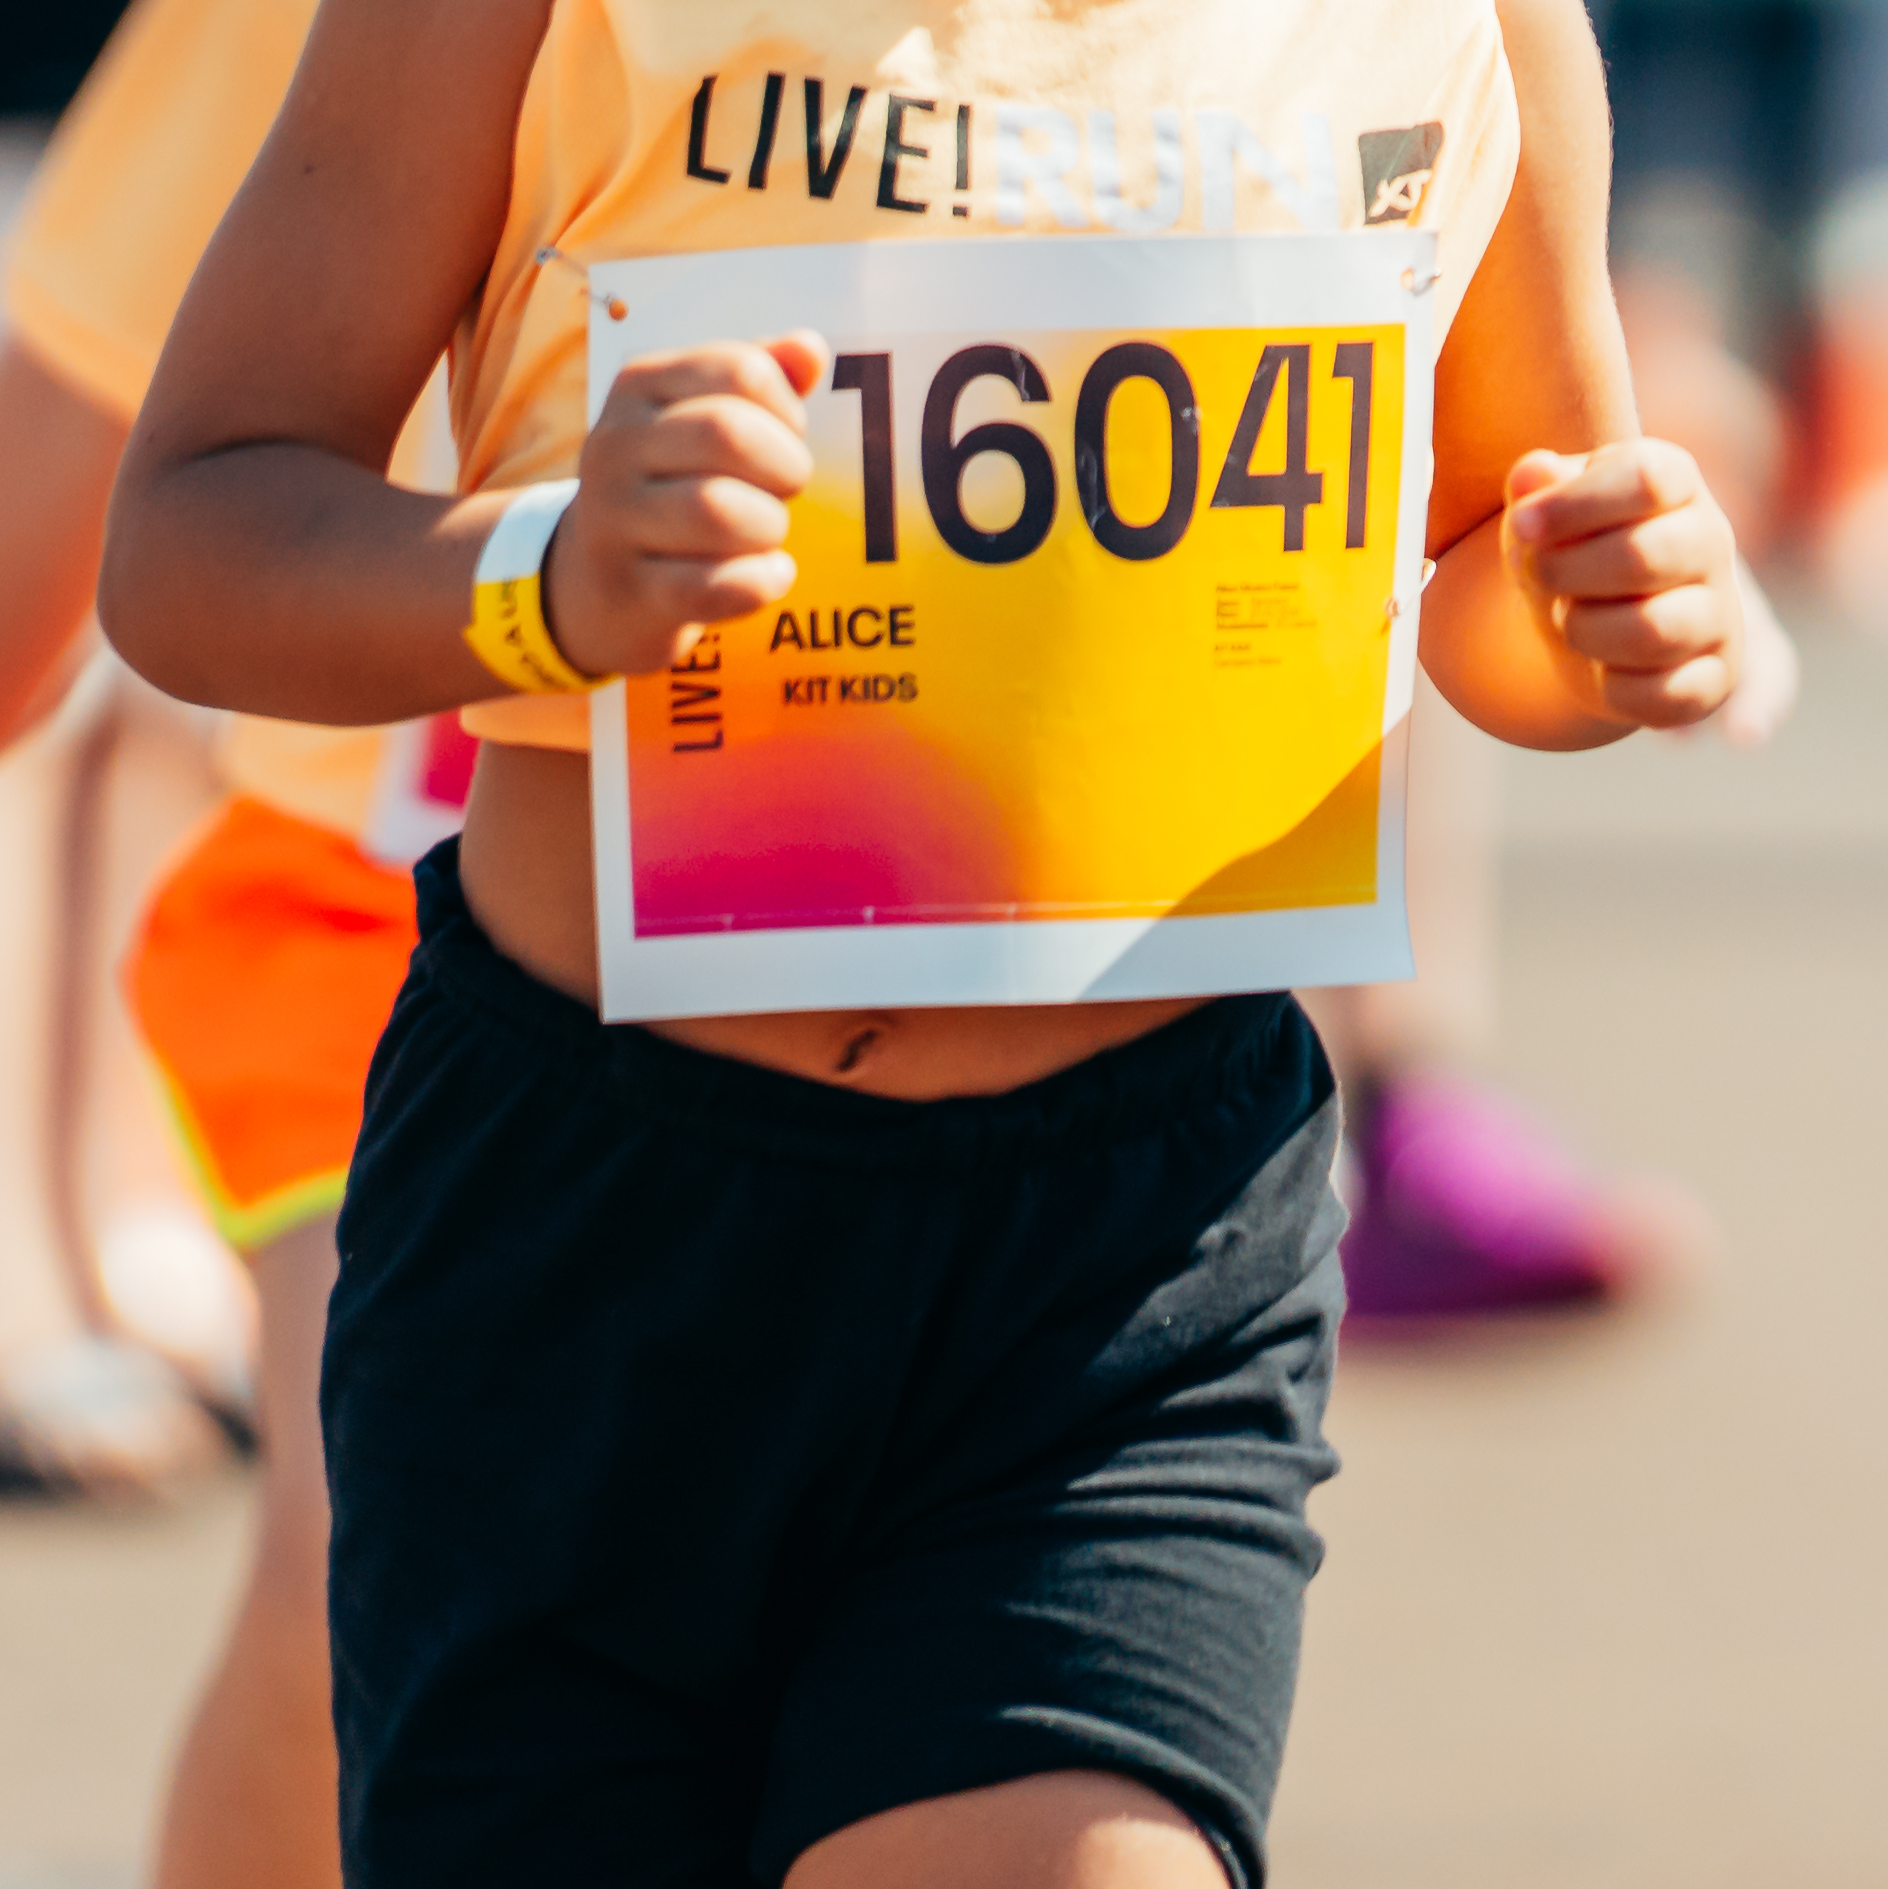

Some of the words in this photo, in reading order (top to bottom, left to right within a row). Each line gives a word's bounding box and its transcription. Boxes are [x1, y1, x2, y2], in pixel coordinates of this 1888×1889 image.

[831, 342, 1374, 564] 16041
[769, 604, 915, 652] ALICE
[783, 676, 831, 705] KIT
[839, 672, 918, 703] KIDS
